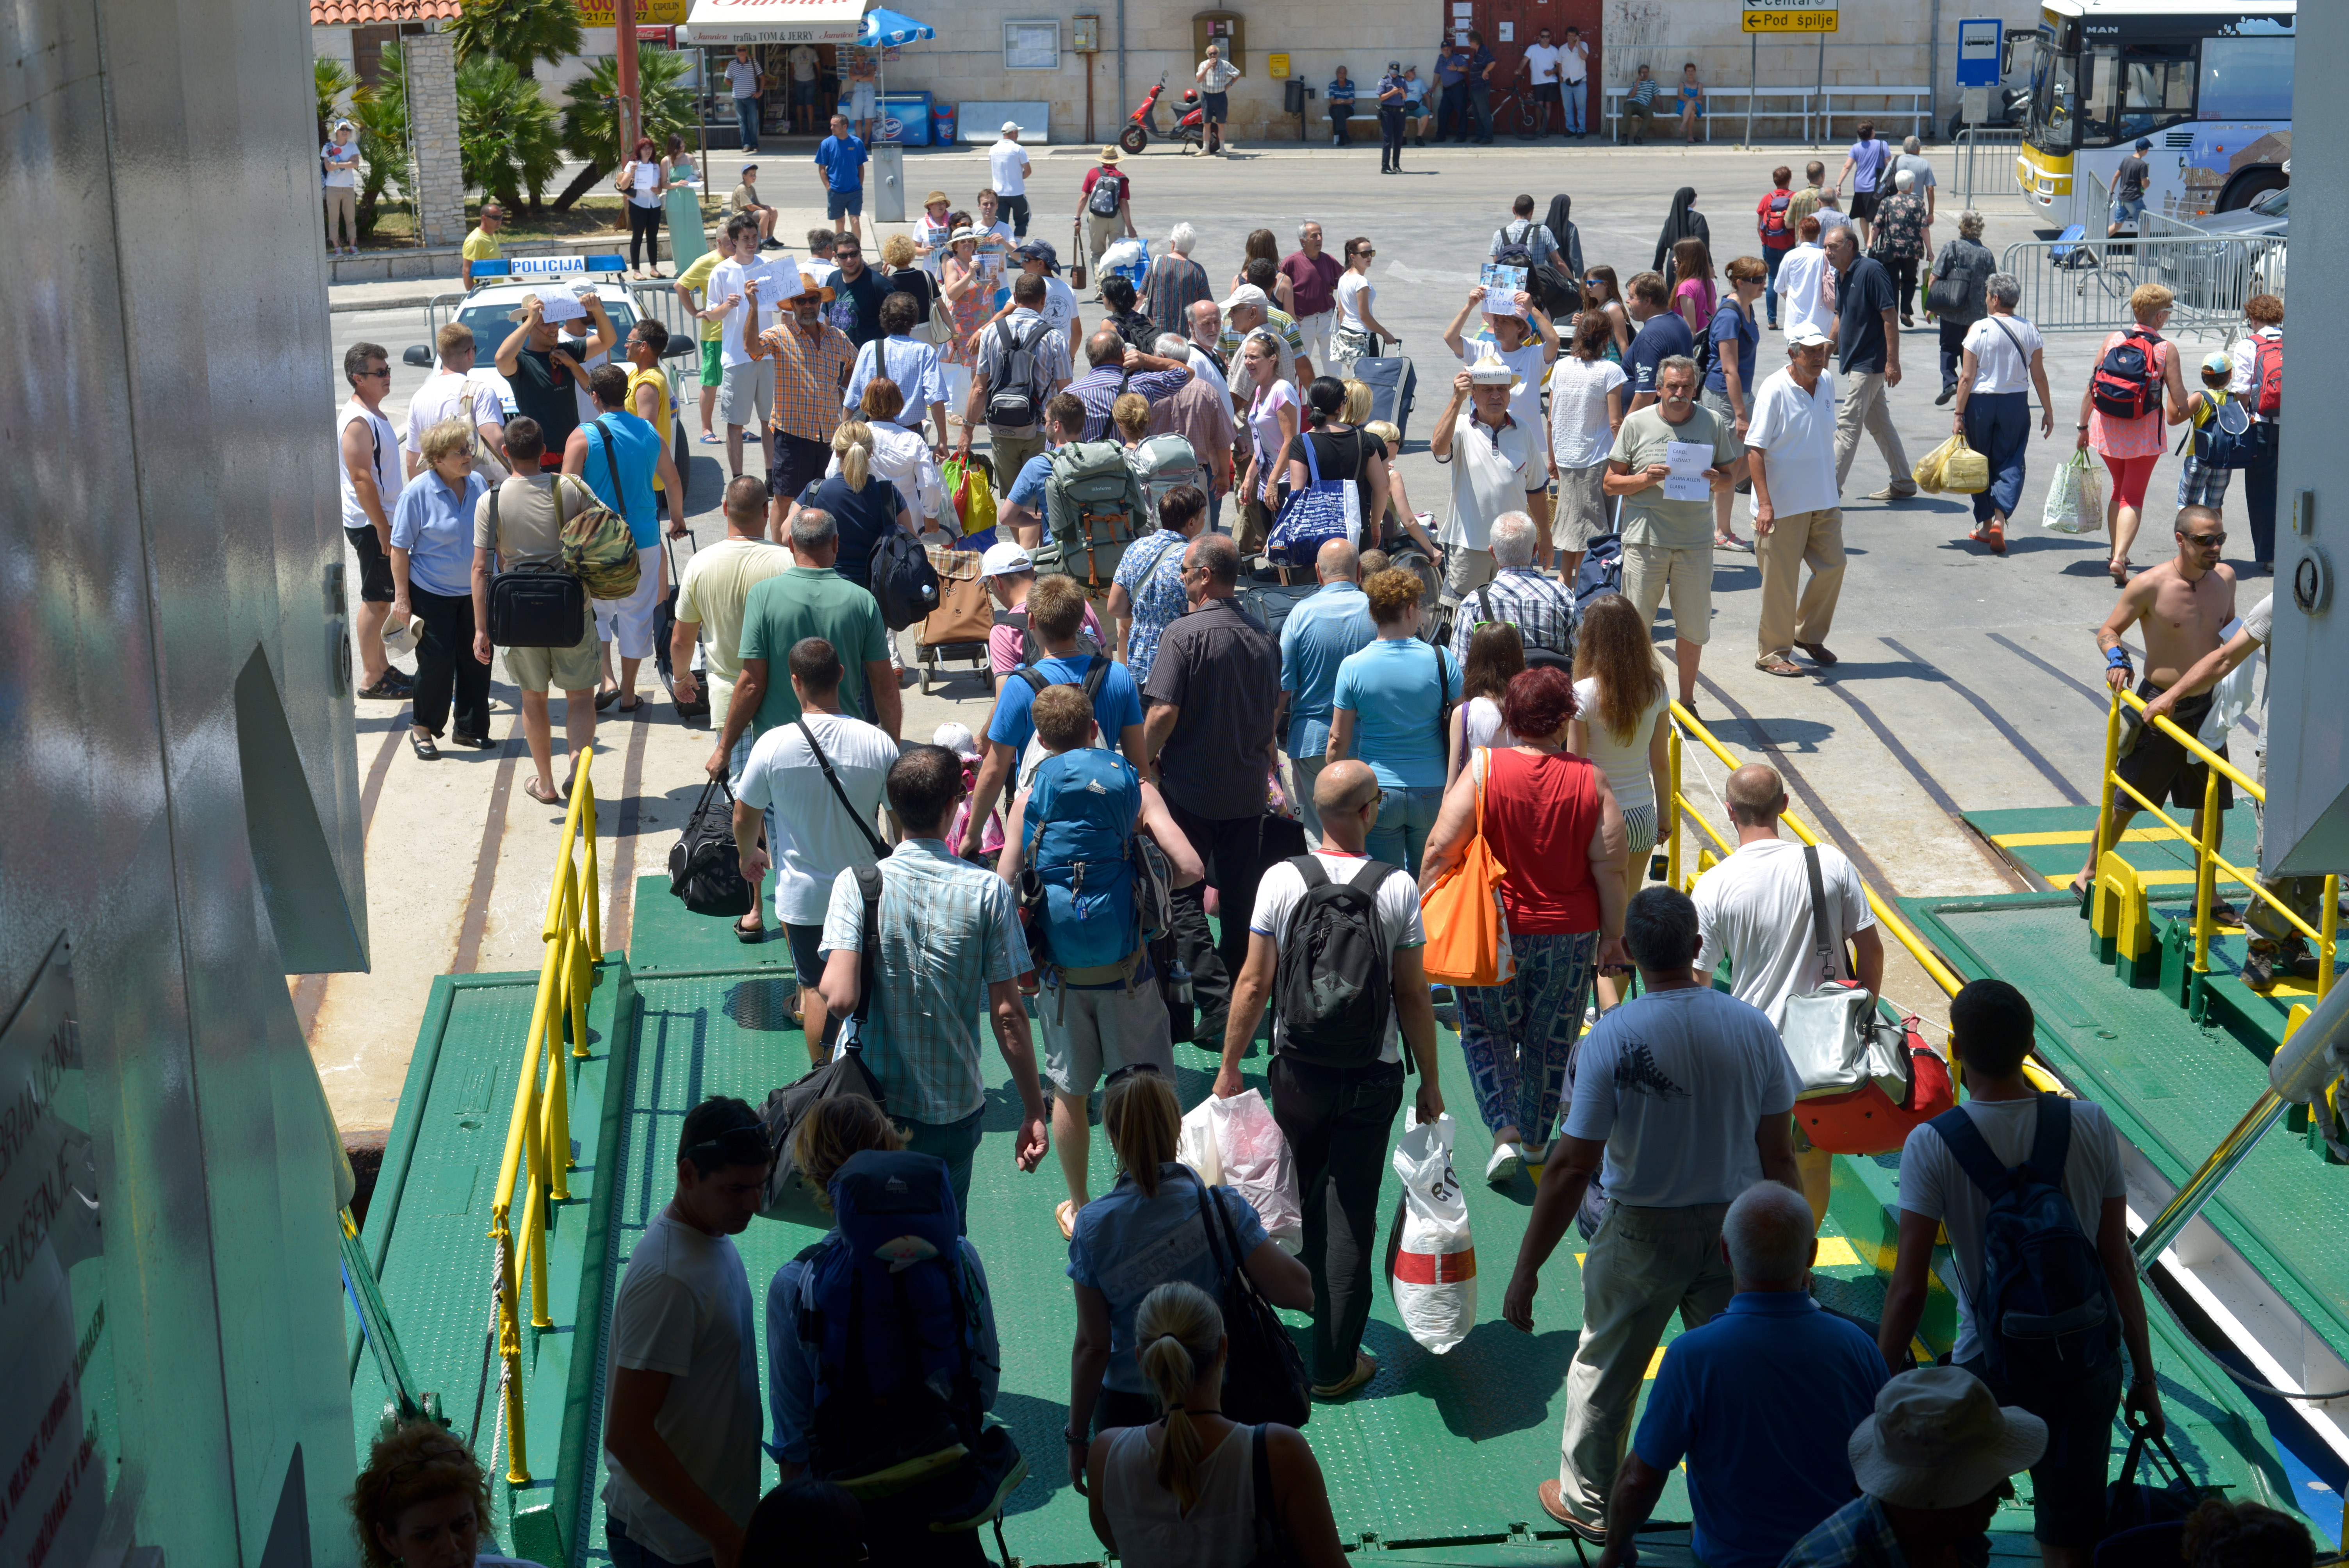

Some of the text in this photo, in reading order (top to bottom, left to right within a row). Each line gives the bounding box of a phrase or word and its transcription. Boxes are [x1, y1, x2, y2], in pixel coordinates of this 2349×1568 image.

[1764, 14, 1833, 28] Pod špilje
[758, 32, 777, 41] TOM
[780, 32, 785, 41] &
[787, 31, 814, 41] JERRY
[819, 31, 854, 39] Jamnica
[512, 259, 583, 273] POLICIJA
[759, 267, 784, 286] LUCY
[759, 280, 797, 301] GARCIA
[1486, 290, 1504, 298] JIM
